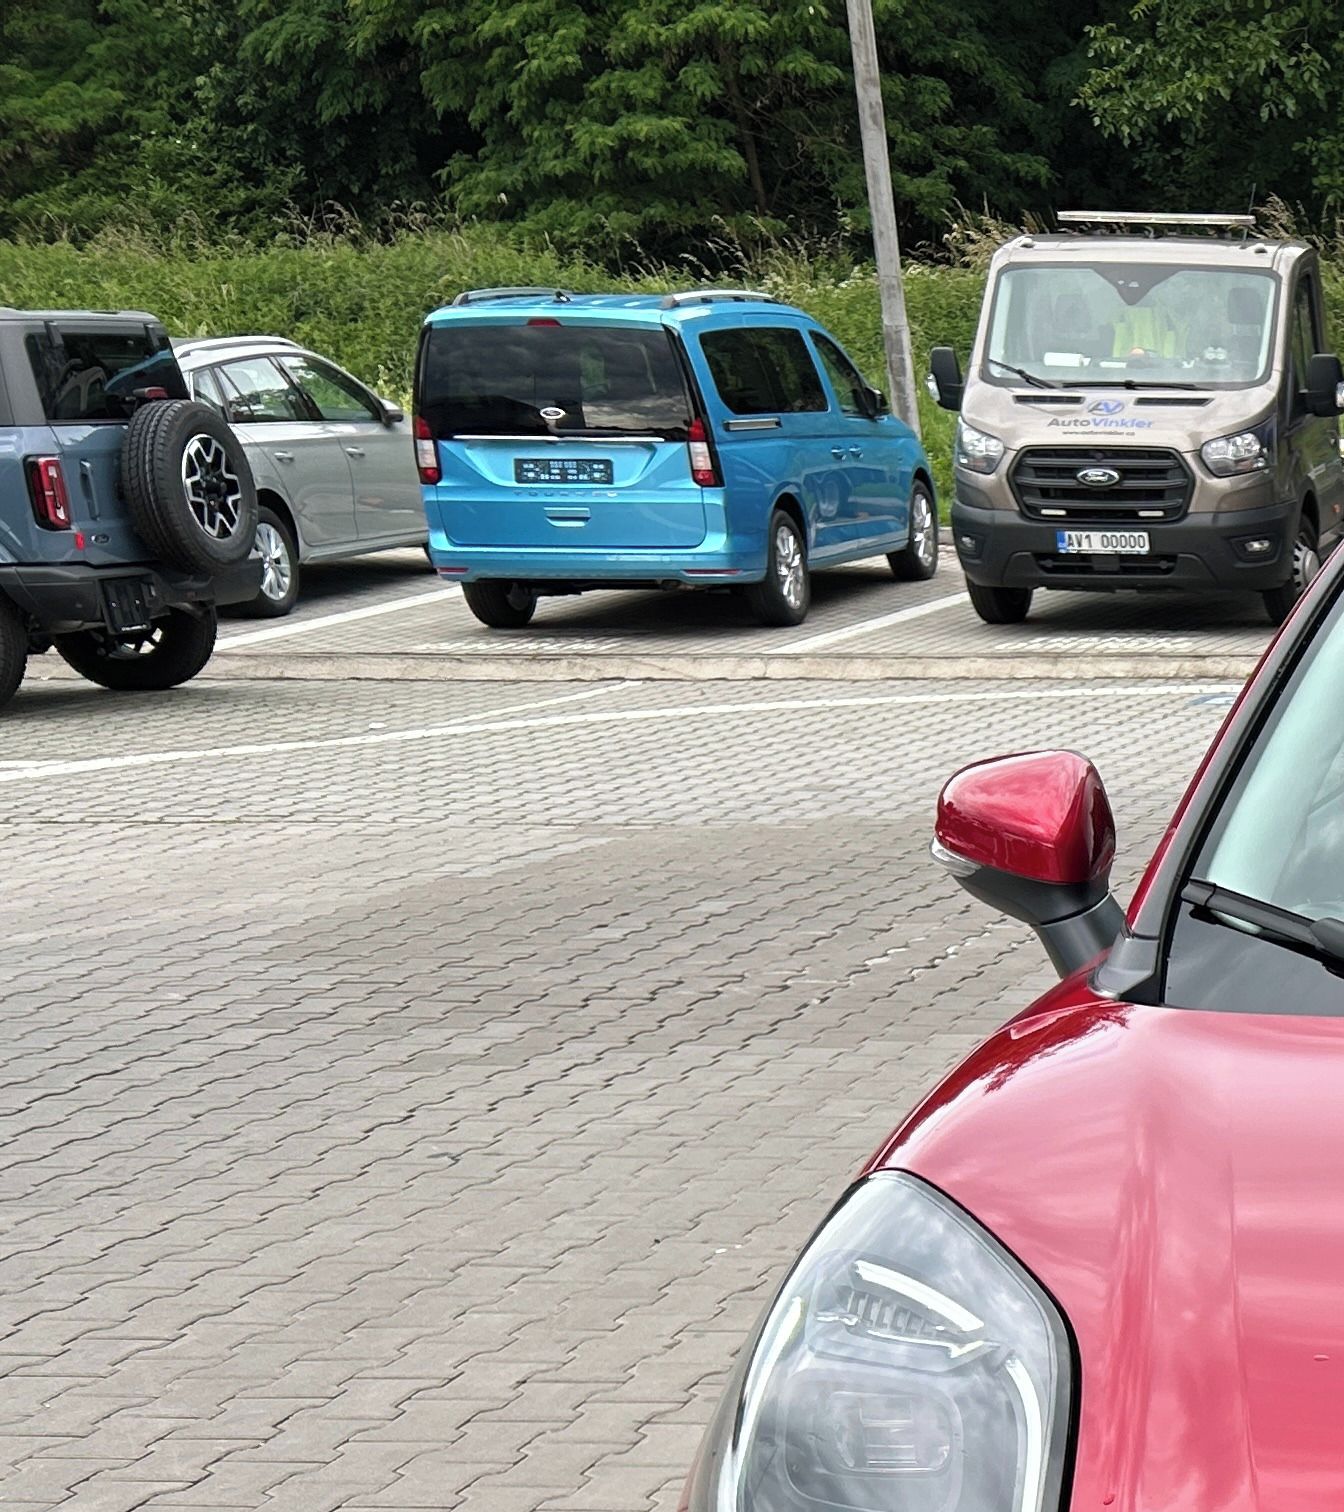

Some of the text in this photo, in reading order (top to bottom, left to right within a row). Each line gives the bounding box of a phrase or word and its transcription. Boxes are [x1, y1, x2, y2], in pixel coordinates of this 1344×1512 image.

[1048, 418, 1153, 428] AutoVinkler
[1067, 534, 1146, 549] AV1 00000
